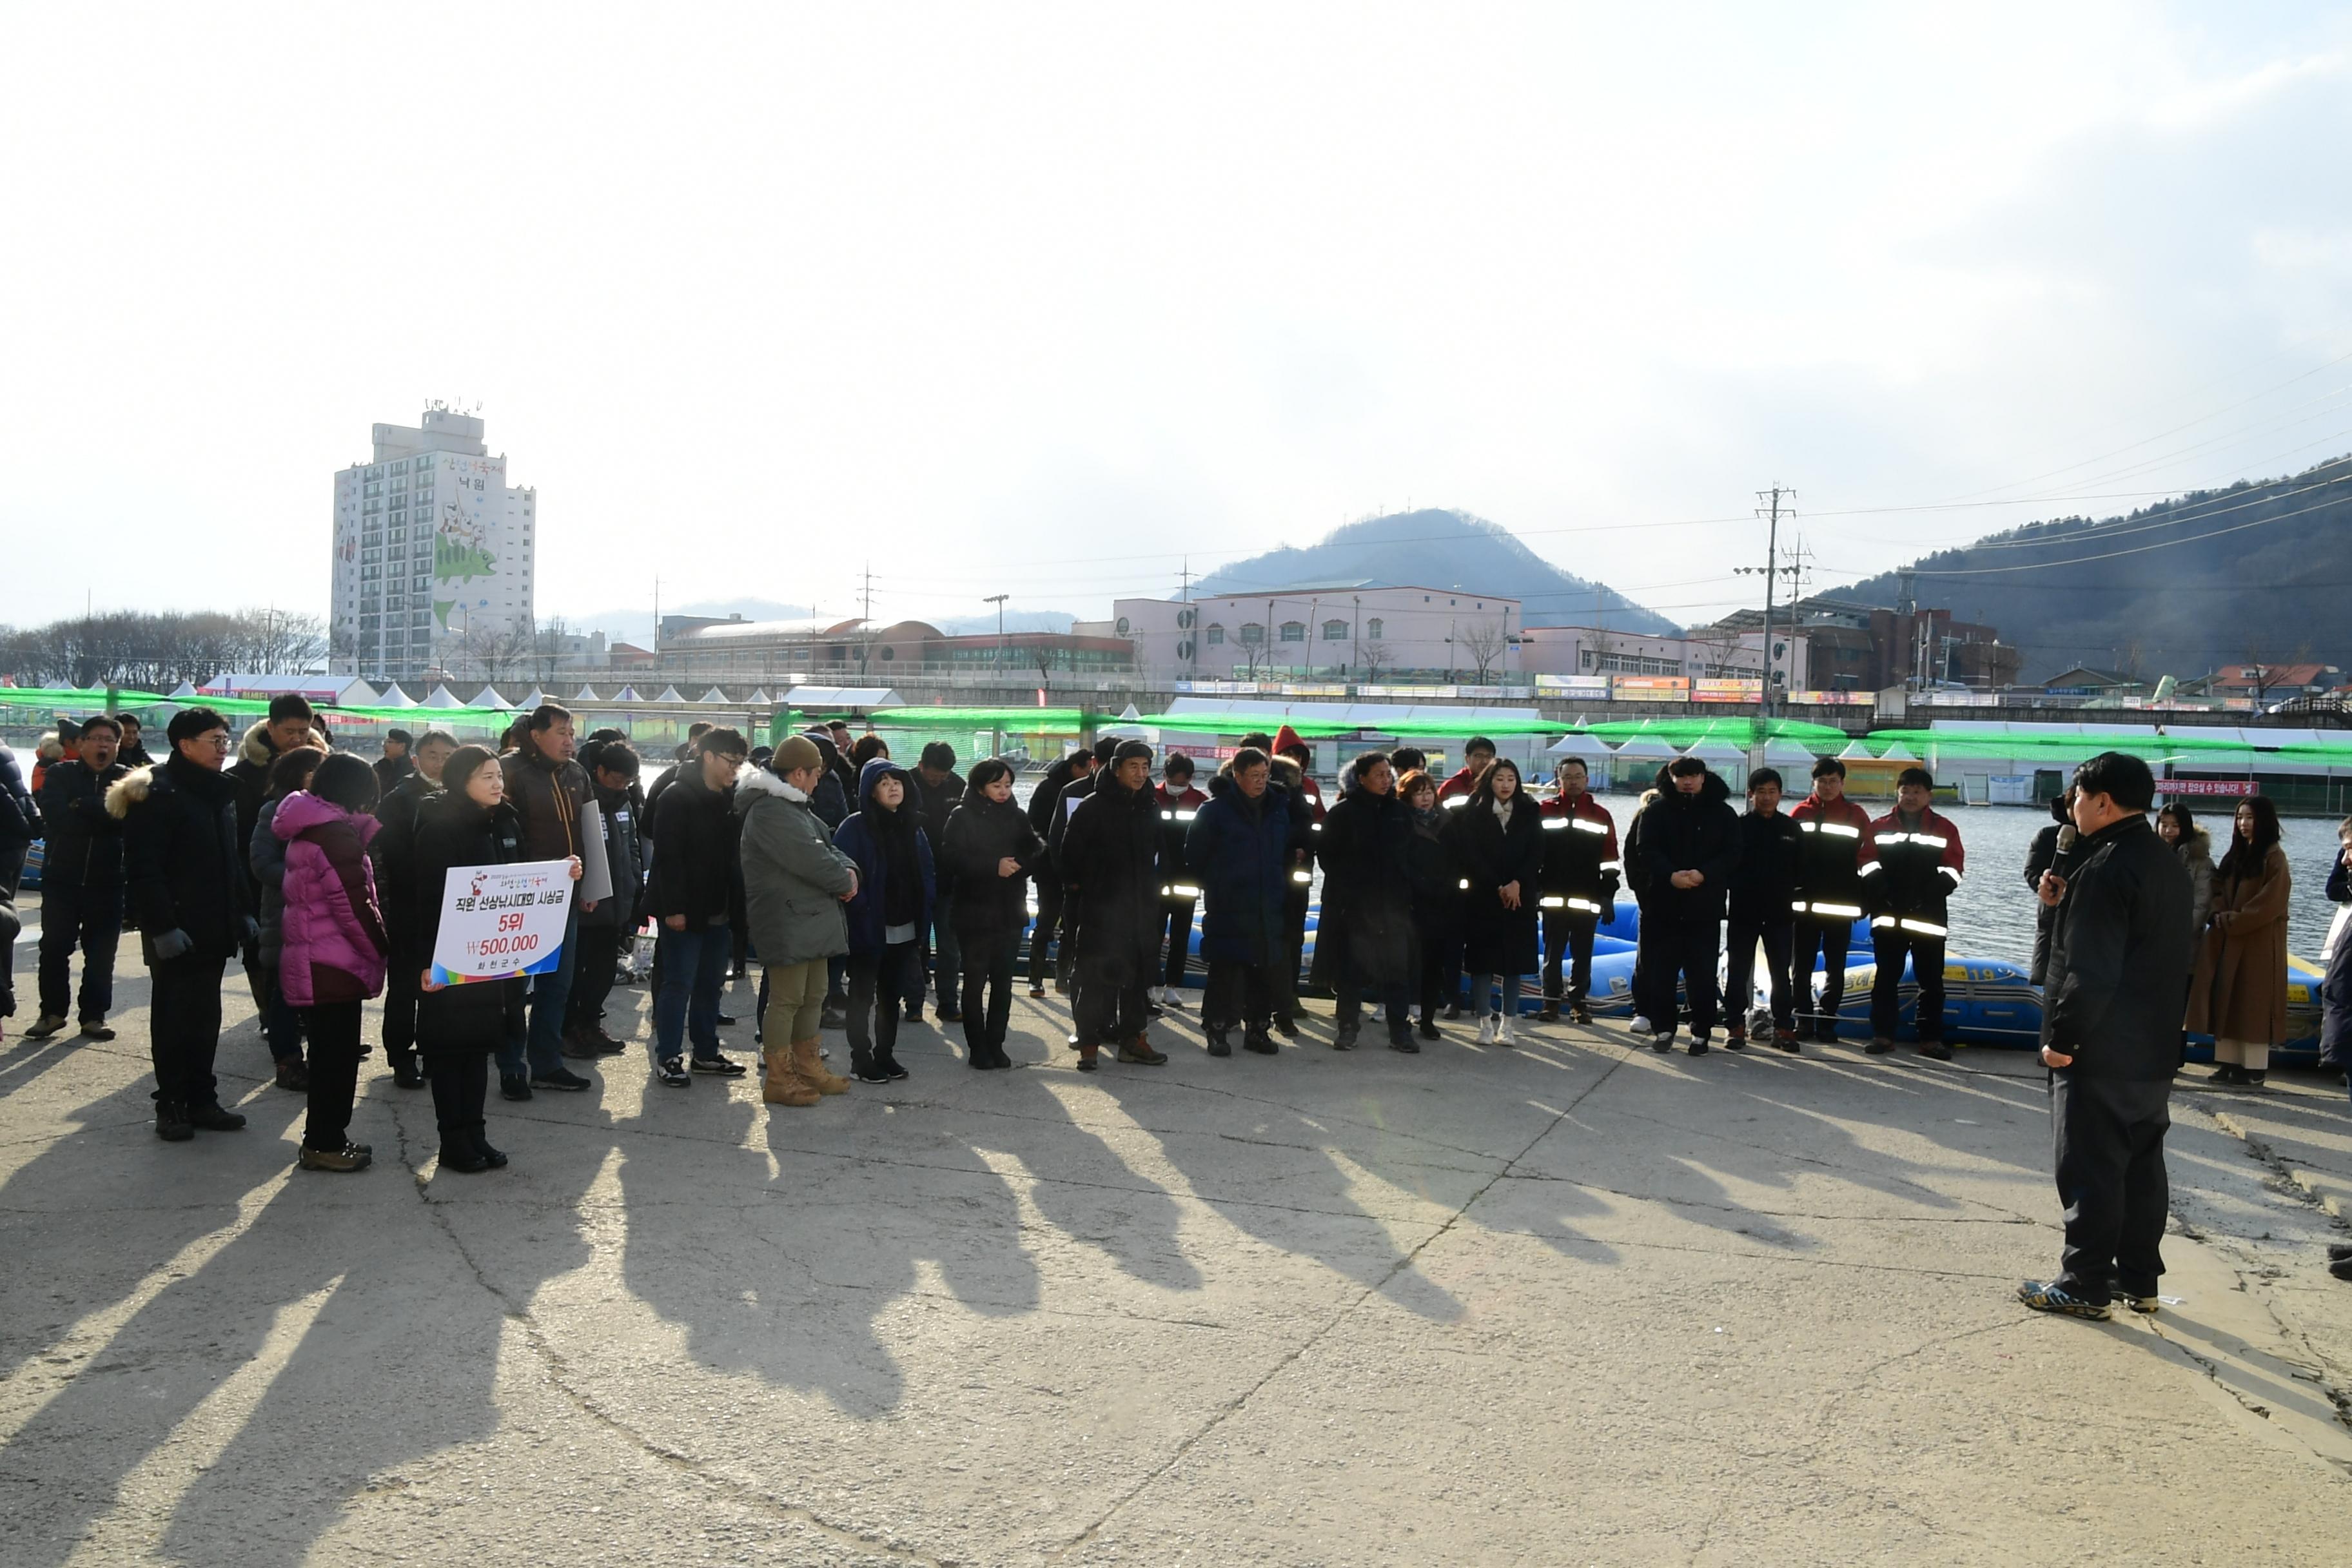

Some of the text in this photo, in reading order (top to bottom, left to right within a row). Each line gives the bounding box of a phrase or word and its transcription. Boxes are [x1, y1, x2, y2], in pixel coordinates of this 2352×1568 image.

[2188, 782, 2205, 793] 잡으실
[2206, 783, 2213, 793] 수
[456, 890, 565, 912] 직원 선상낚시대회 시상금
[498, 912, 525, 932] 5위
[1970, 969, 1994, 981] 19
